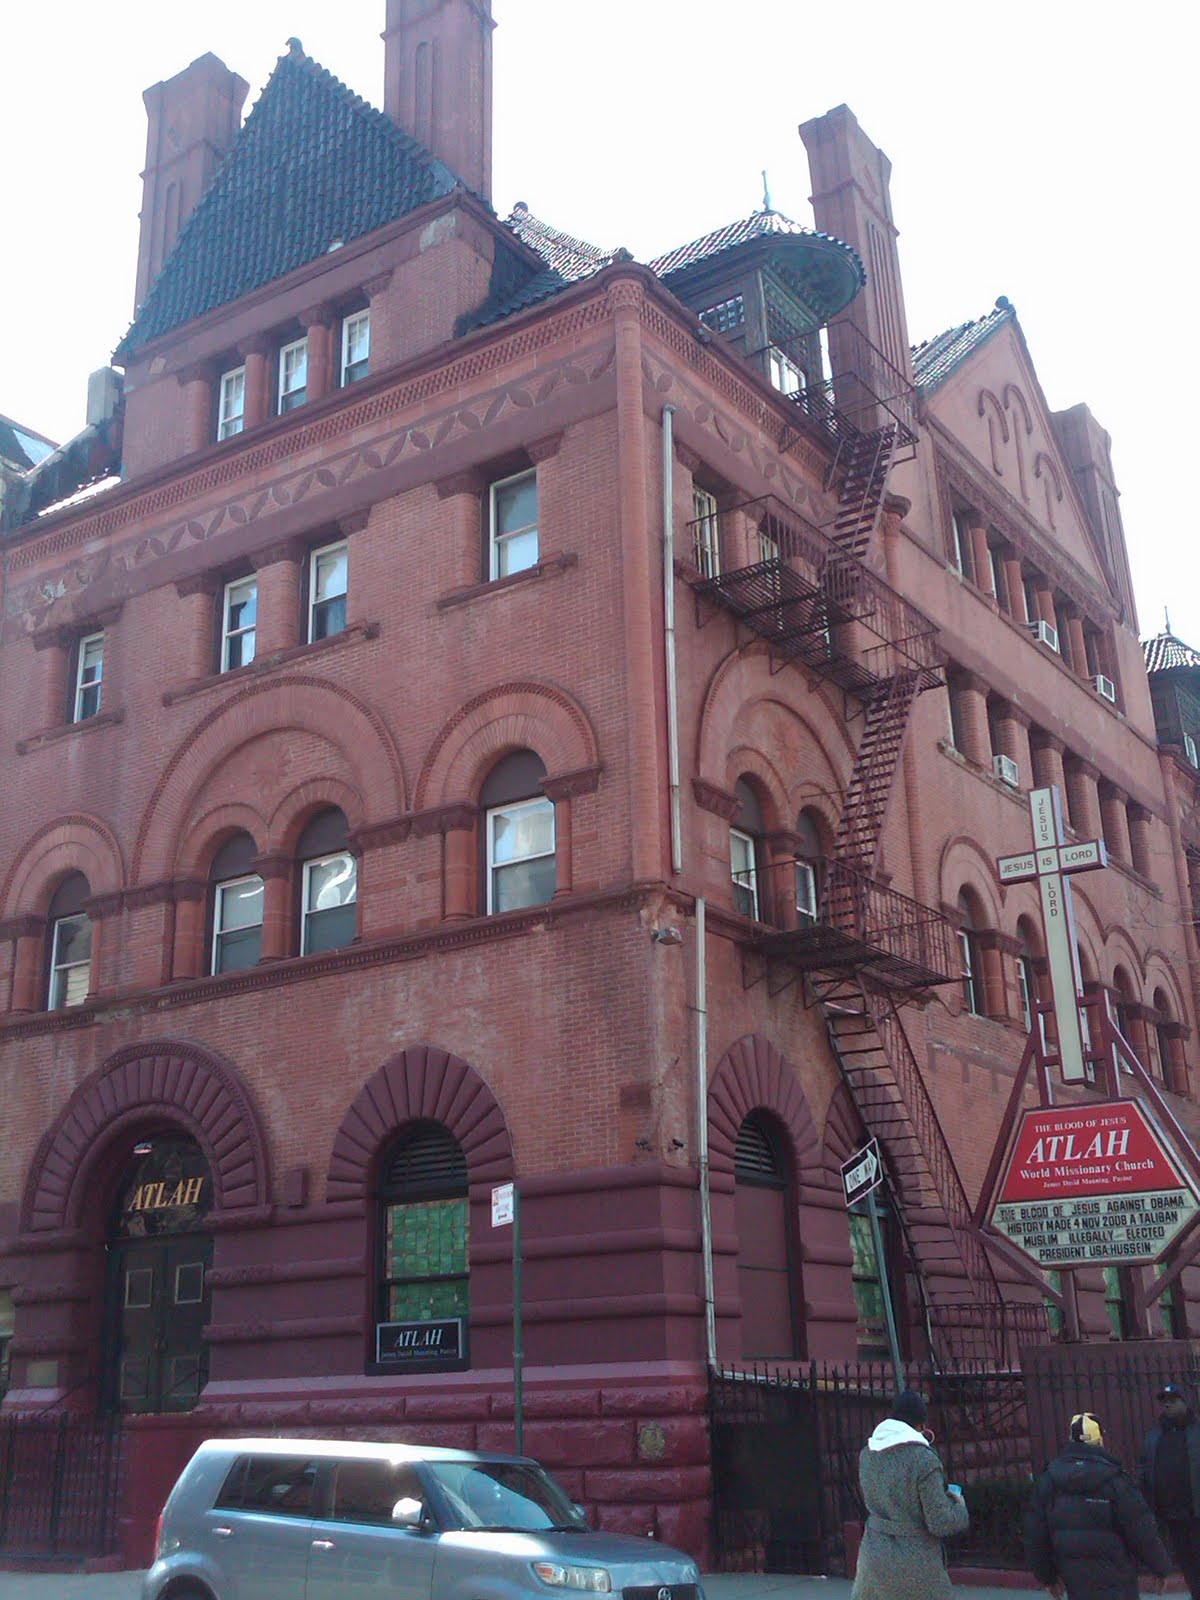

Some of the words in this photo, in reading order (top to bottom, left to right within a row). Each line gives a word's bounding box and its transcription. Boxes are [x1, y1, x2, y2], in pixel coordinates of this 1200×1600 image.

[1002, 861, 1034, 873] JESUS
[1042, 857, 1052, 866] IS
[1065, 849, 1093, 862] LORD
[1035, 1125, 1051, 1133] THE
[1054, 1121, 1083, 1131] BLOOD
[1085, 1119, 1098, 1128] OF
[1100, 1116, 1127, 1126] JESUS
[1026, 1128, 1130, 1164] ATLAH
[1020, 1167, 1050, 1179] World
[1055, 1164, 1111, 1176] Missionary
[1115, 1158, 1154, 1171] Church
[128, 1177, 204, 1212] ATLAH
[1020, 1206, 1048, 1219] BLOOD
[1053, 1205, 1063, 1217] OF
[1071, 1202, 1100, 1215] JESUS
[1107, 1198, 1145, 1212] AGAINST
[1150, 1196, 1185, 1209] OBAMA
[1007, 1220, 1044, 1233] HISTORY
[1046, 1218, 1071, 1231] MADE
[1073, 1218, 1080, 1229] 4
[1082, 1216, 1100, 1229] NOV
[1102, 1214, 1127, 1227] 2008
[1129, 1213, 1137, 1225] A
[1139, 1210, 1178, 1224] TALIBAN
[1023, 1234, 1059, 1247] MUSLIM
[1068, 1230, 1114, 1244] ILLEGALLY
[1126, 1226, 1165, 1240] ELECTED
[1039, 1245, 1086, 1259] PRESIDENT
[394, 1329, 442, 1348] ATLAH
